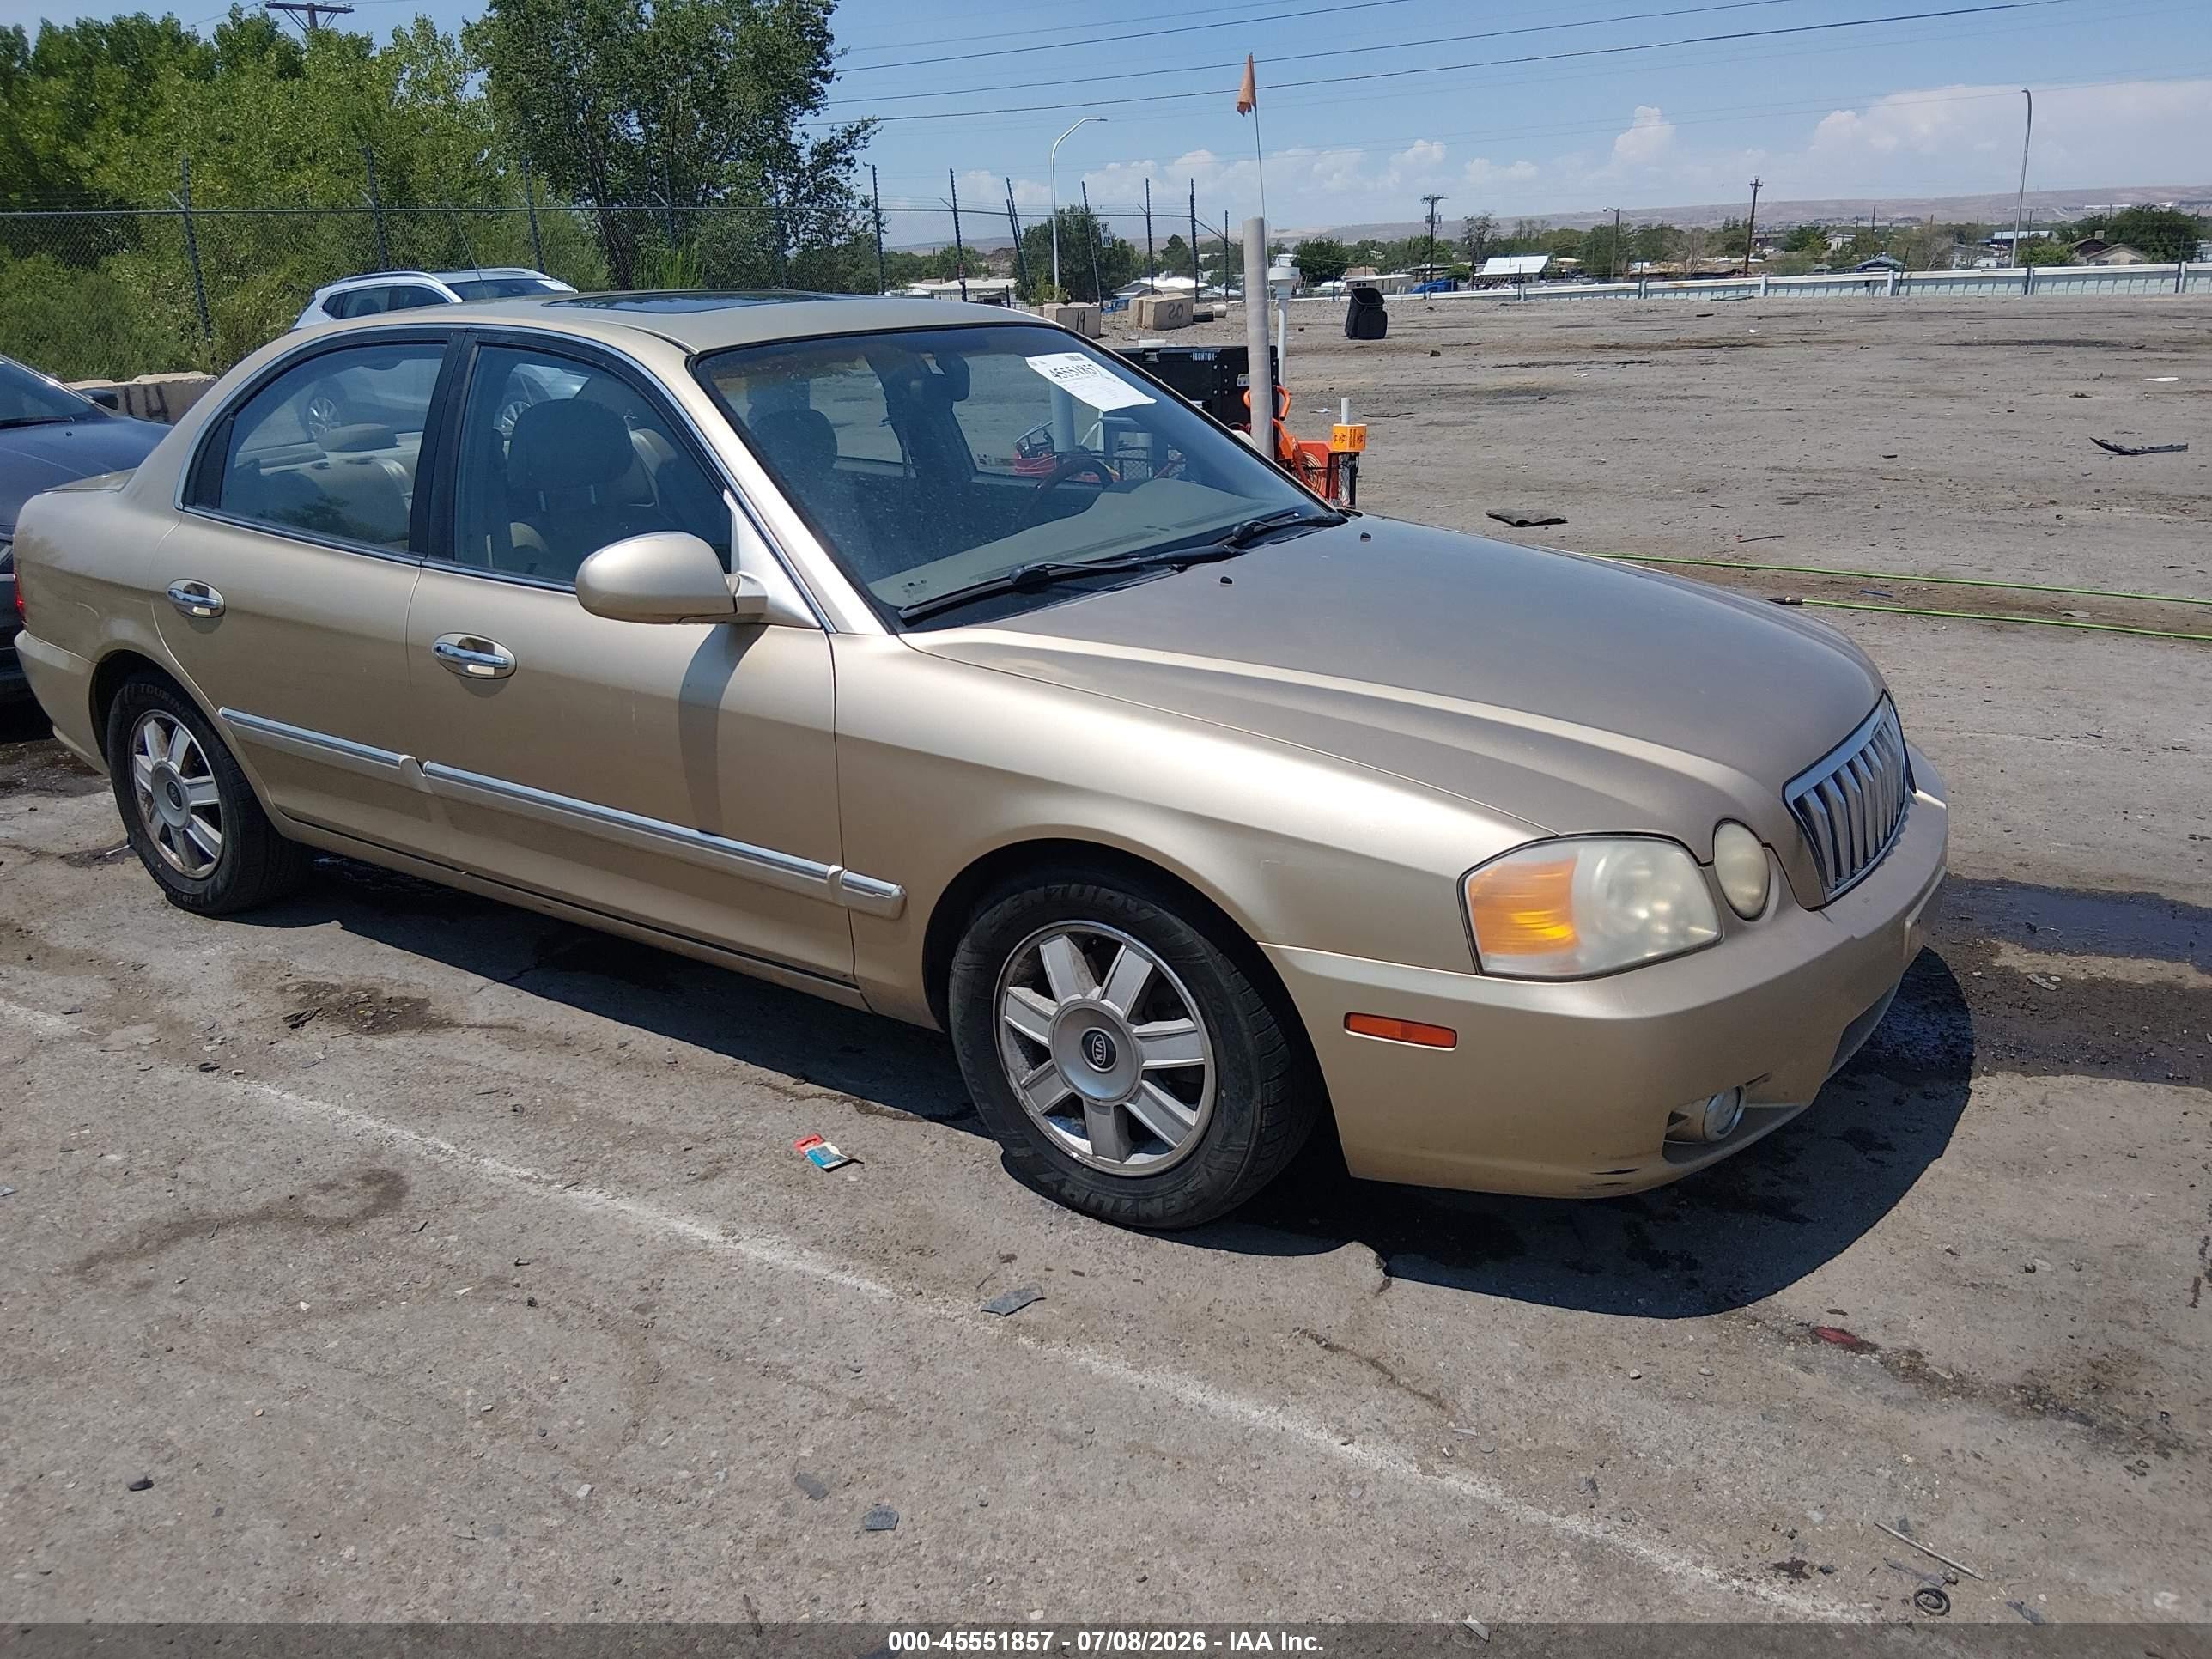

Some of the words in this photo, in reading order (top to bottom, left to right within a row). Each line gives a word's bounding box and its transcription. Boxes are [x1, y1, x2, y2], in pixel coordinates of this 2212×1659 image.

[1168, 302, 1183, 319] 20
[1077, 310, 1086, 335] 19
[1049, 363, 1103, 380] 45551857
